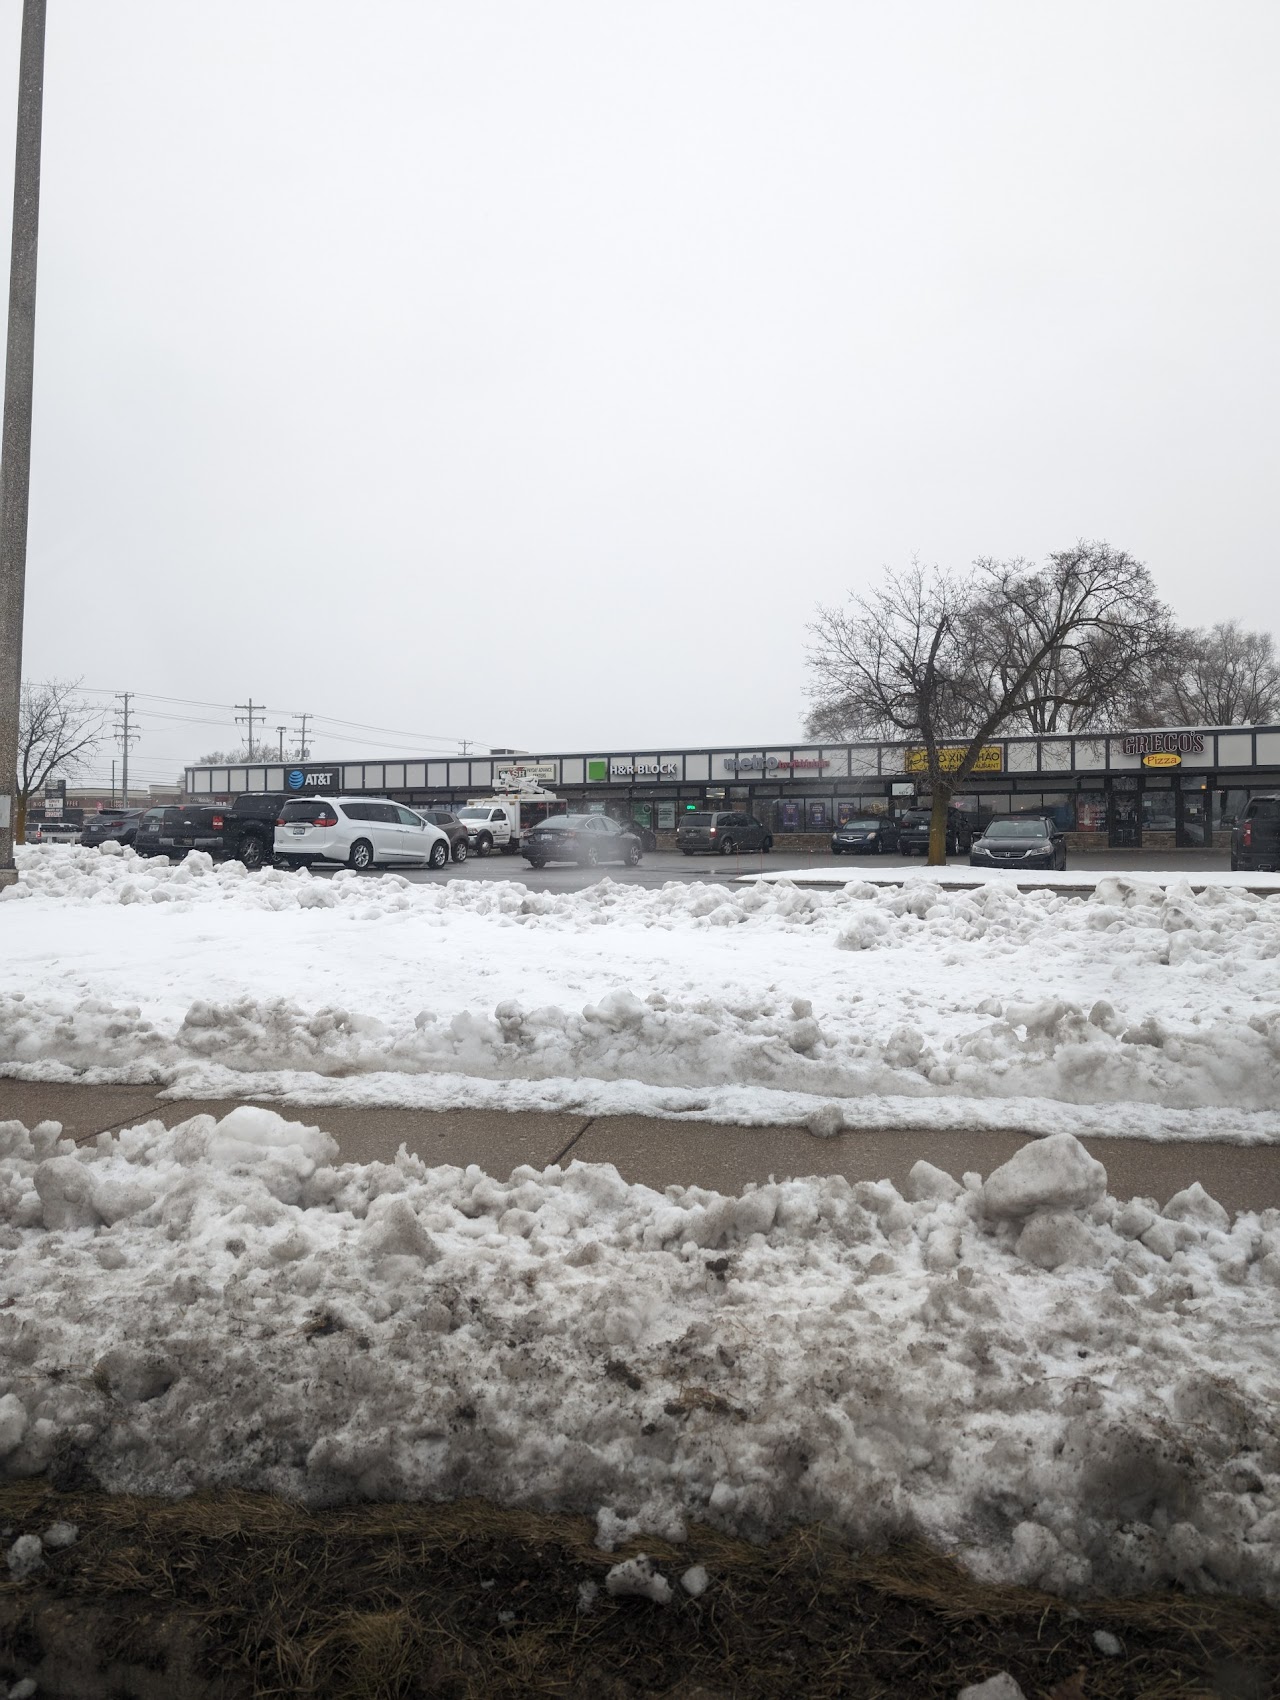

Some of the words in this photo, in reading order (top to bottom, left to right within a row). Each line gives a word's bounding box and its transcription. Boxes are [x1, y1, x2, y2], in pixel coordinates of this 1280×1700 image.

[1122, 731, 1205, 755] GRECO'S
[723, 755, 778, 771] metro
[1147, 756, 1177, 765] Pizza
[610, 765, 634, 775] H&R
[637, 763, 676, 774] BLOCK
[304, 773, 333, 786] AT&T
